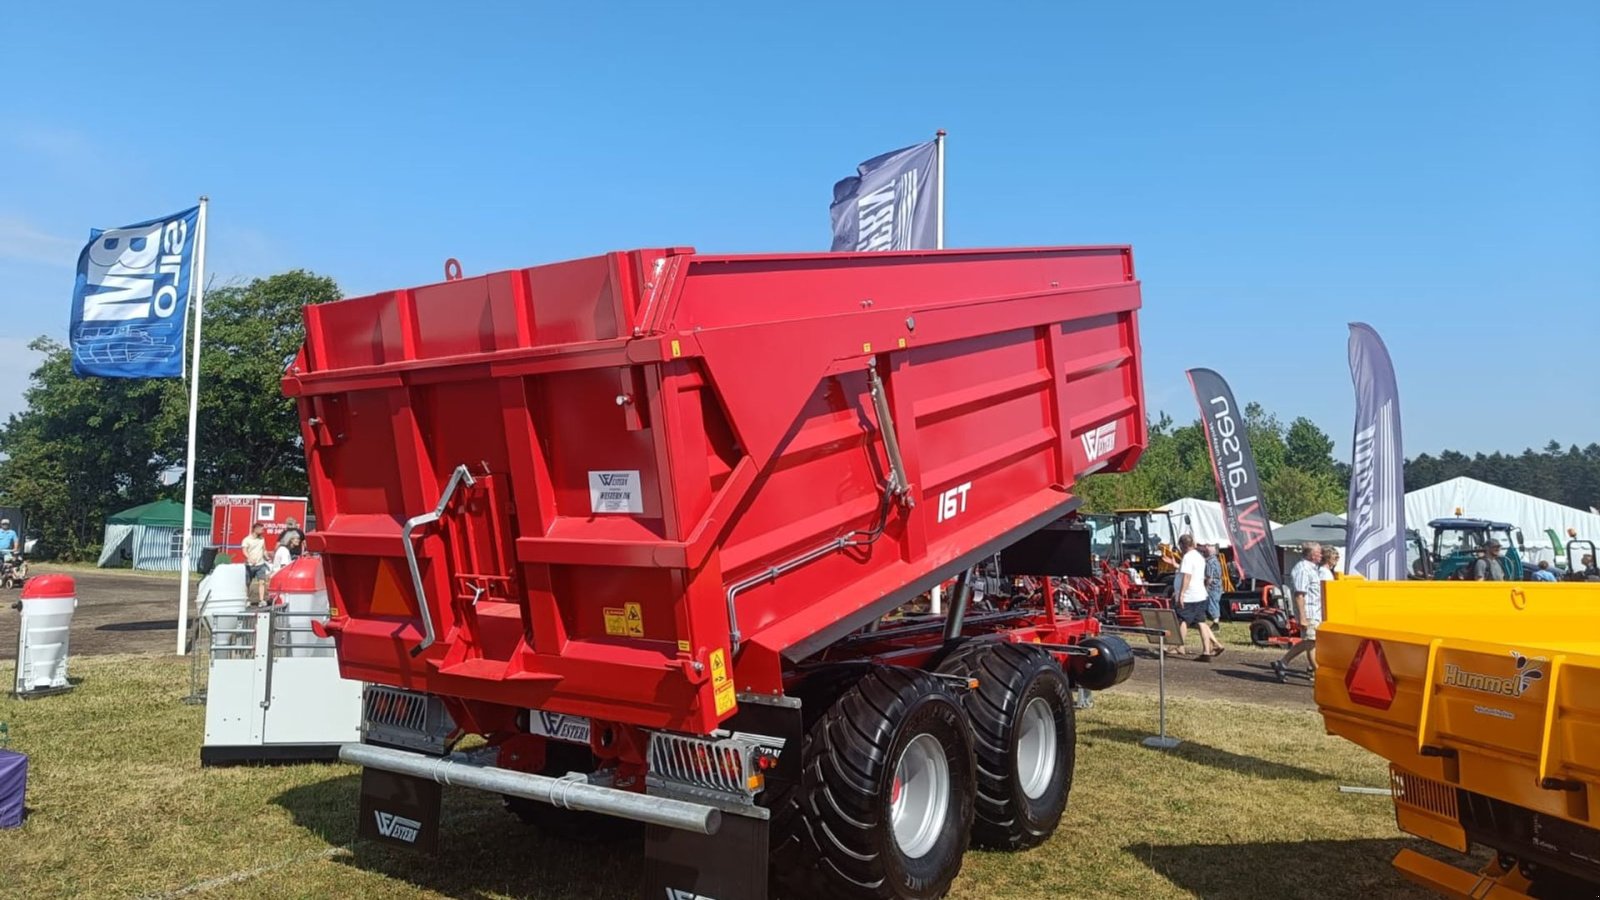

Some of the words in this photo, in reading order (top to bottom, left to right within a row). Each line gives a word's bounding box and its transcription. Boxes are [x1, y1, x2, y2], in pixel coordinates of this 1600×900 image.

[937, 481, 971, 524] 16T
[1444, 664, 1521, 697] Hummel
[539, 711, 589, 741] WESTERN
[374, 810, 421, 843] WESTERN
